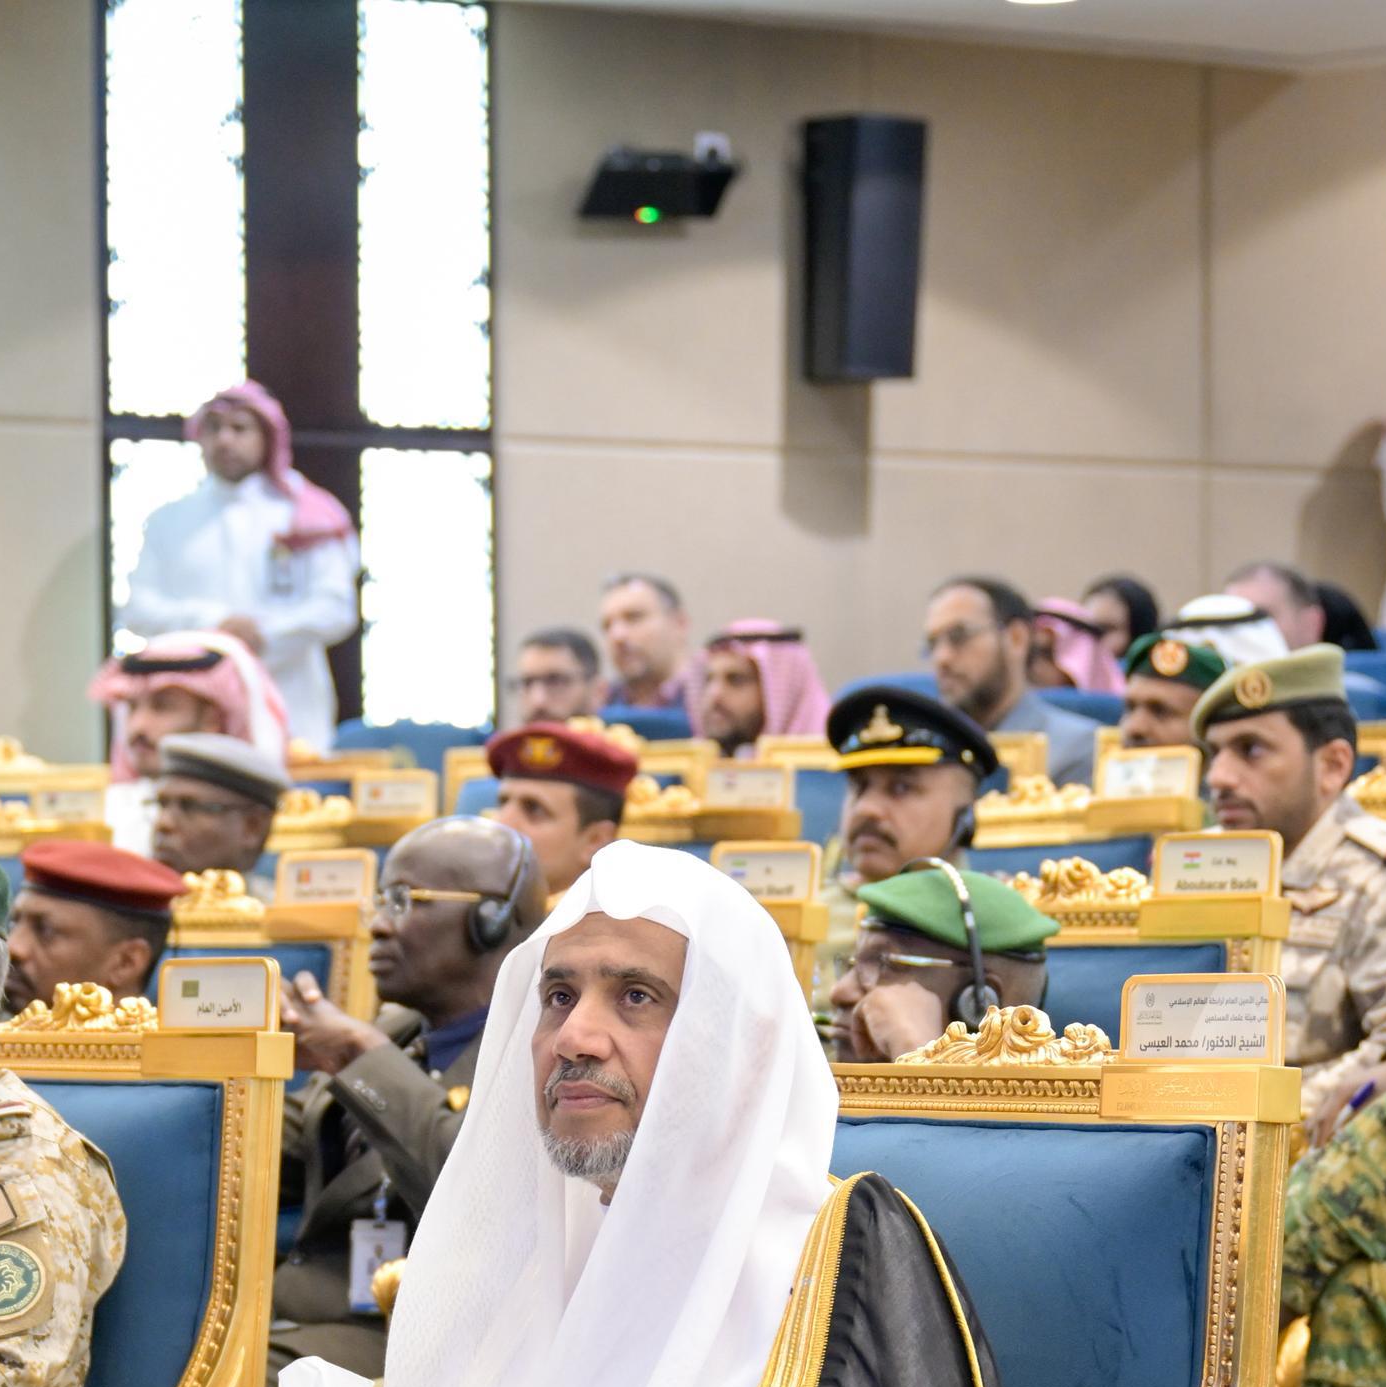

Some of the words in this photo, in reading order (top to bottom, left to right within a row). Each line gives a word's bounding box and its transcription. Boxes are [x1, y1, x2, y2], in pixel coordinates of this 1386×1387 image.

[197, 1002, 214, 1017] العام
[216, 998, 241, 1017] الأمين
[1139, 1036, 1172, 1051] العيسى
[1175, 1039, 1199, 1048] محمد
[1238, 1033, 1265, 1051] الشيخ
